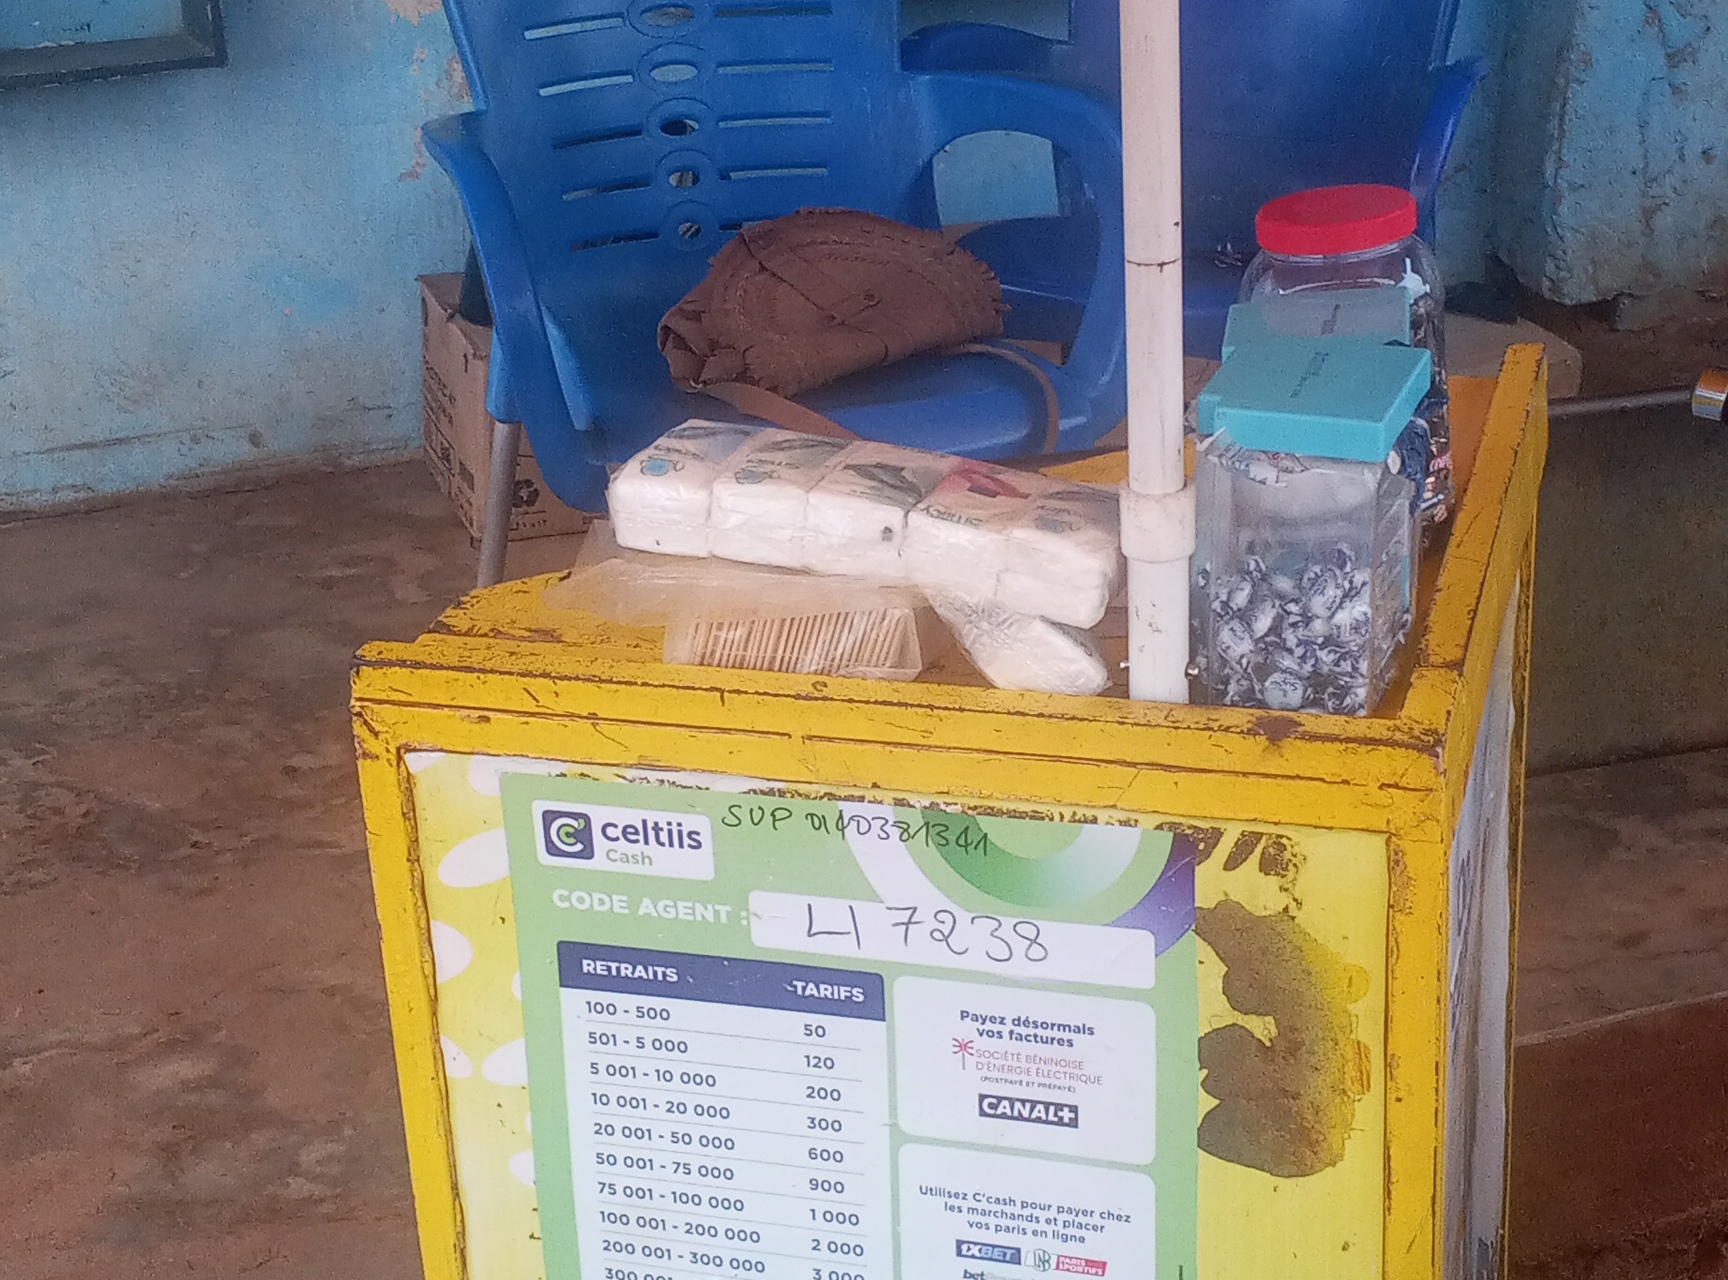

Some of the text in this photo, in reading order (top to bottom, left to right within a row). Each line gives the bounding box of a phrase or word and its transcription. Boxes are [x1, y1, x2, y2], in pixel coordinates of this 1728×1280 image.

[721, 804, 793, 831] SUP
[600, 818, 703, 850] celtiis
[606, 849, 653, 867] Cash
[552, 888, 629, 914] CODE
[637, 898, 732, 925] AGENT
[581, 959, 679, 983] RETRAITS
[793, 980, 865, 1002] TARIFS
[586, 1001, 670, 1021] 100 500
[959, 1010, 1095, 1036] Payez désormais
[589, 1032, 688, 1053] 501 5 000
[804, 1024, 826, 1038] 50
[976, 1027, 1074, 1048] vos factures
[804, 1055, 834, 1070] 120
[975, 1048, 1084, 1070] SOCIÉTÉ BÉNINOISE
[590, 1062, 716, 1087] 5 001 10 000
[975, 1061, 1103, 1086] D'ÉNERGIE ÉLECTRIQUE
[806, 1086, 841, 1101] 200
[591, 1093, 730, 1119] 10 001 20 000
[981, 1097, 1075, 1124] CANAL+
[807, 1116, 842, 1132] 300
[594, 1123, 735, 1150] 20 001 50 000
[596, 1153, 734, 1180] 50 001 75 000
[808, 1148, 843, 1163] 600
[598, 1182, 744, 1211] 75 001 100 000
[809, 1178, 844, 1193] 900
[919, 1185, 1131, 1223] Utilisez C'cash pour payer chez
[600, 1211, 760, 1243] 100 001 200 000
[810, 1209, 859, 1226] 1 000
[944, 1201, 1105, 1233] les marchands et placer
[967, 1220, 1085, 1244] vos paris en ligne
[602, 1240, 765, 1273] 200 001 300 000
[811, 1239, 864, 1256] 2 000
[813, 1268, 822, 1280] 3
